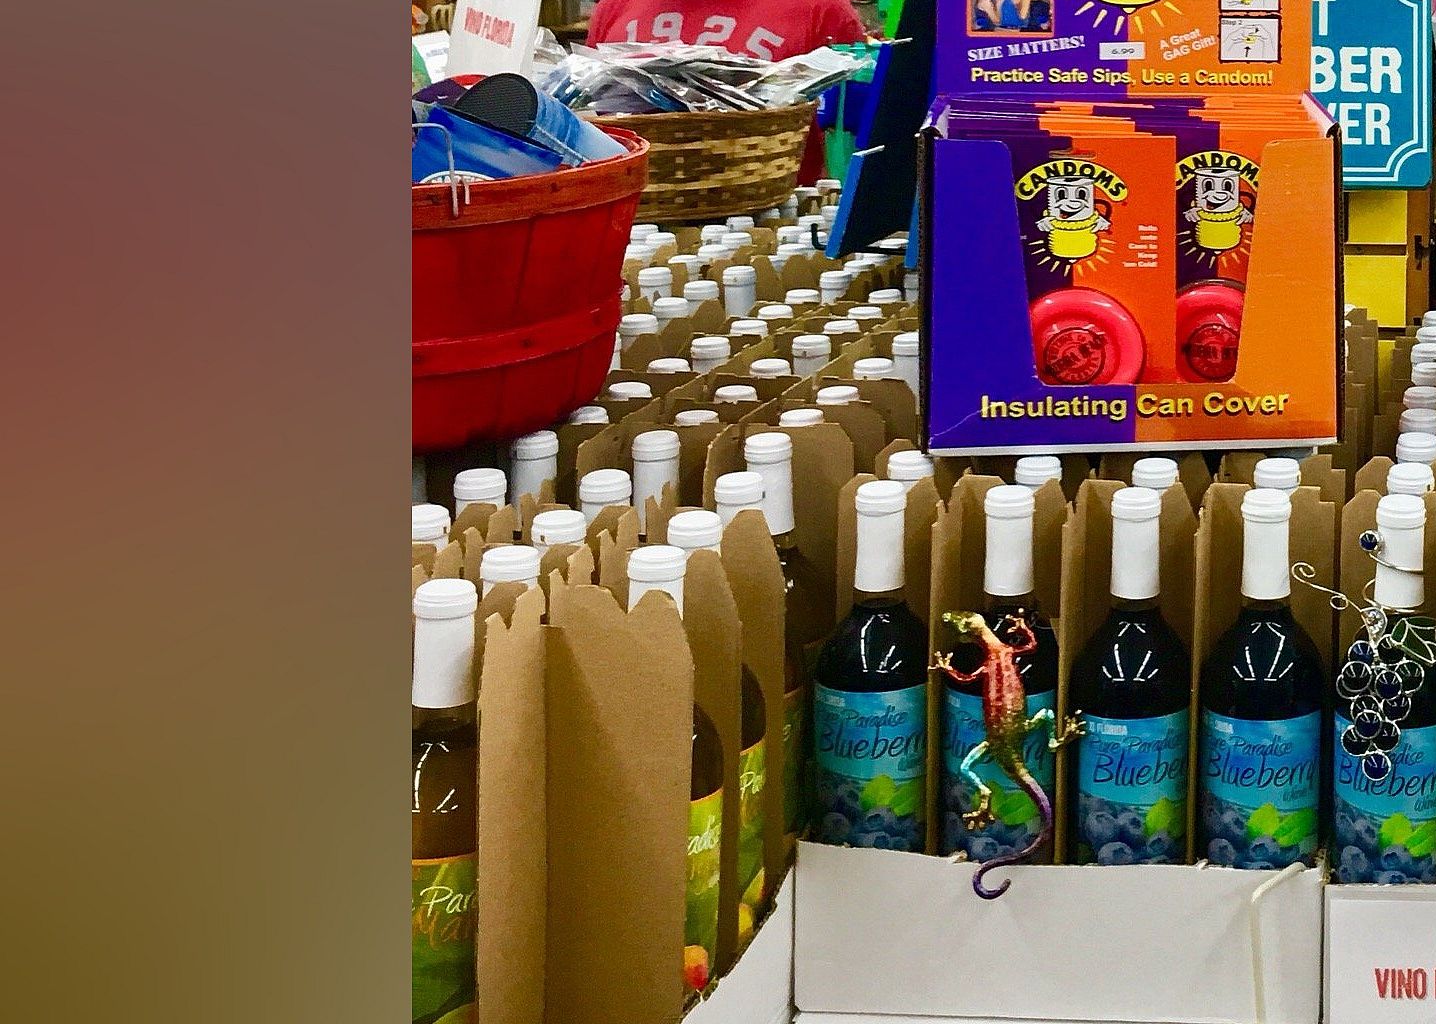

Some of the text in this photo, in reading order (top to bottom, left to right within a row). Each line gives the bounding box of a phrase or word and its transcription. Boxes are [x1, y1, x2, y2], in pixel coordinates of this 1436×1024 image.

[625, 11, 785, 62] 1925
[967, 35, 1085, 63] SIZE MATTERS!
[1159, 29, 1201, 51] A Great
[1111, 48, 1136, 56] 6.99
[1163, 45, 1190, 61] GAG
[971, 67, 1274, 87] Practice Safe Sips, Use a Candom!
[1017, 162, 1126, 198] CANDOMS
[981, 392, 1291, 421] Insulating Can Cover
[845, 704, 908, 731] Paradise
[1229, 734, 1293, 757] Paradise
[1374, 968, 1428, 1001] VINO
